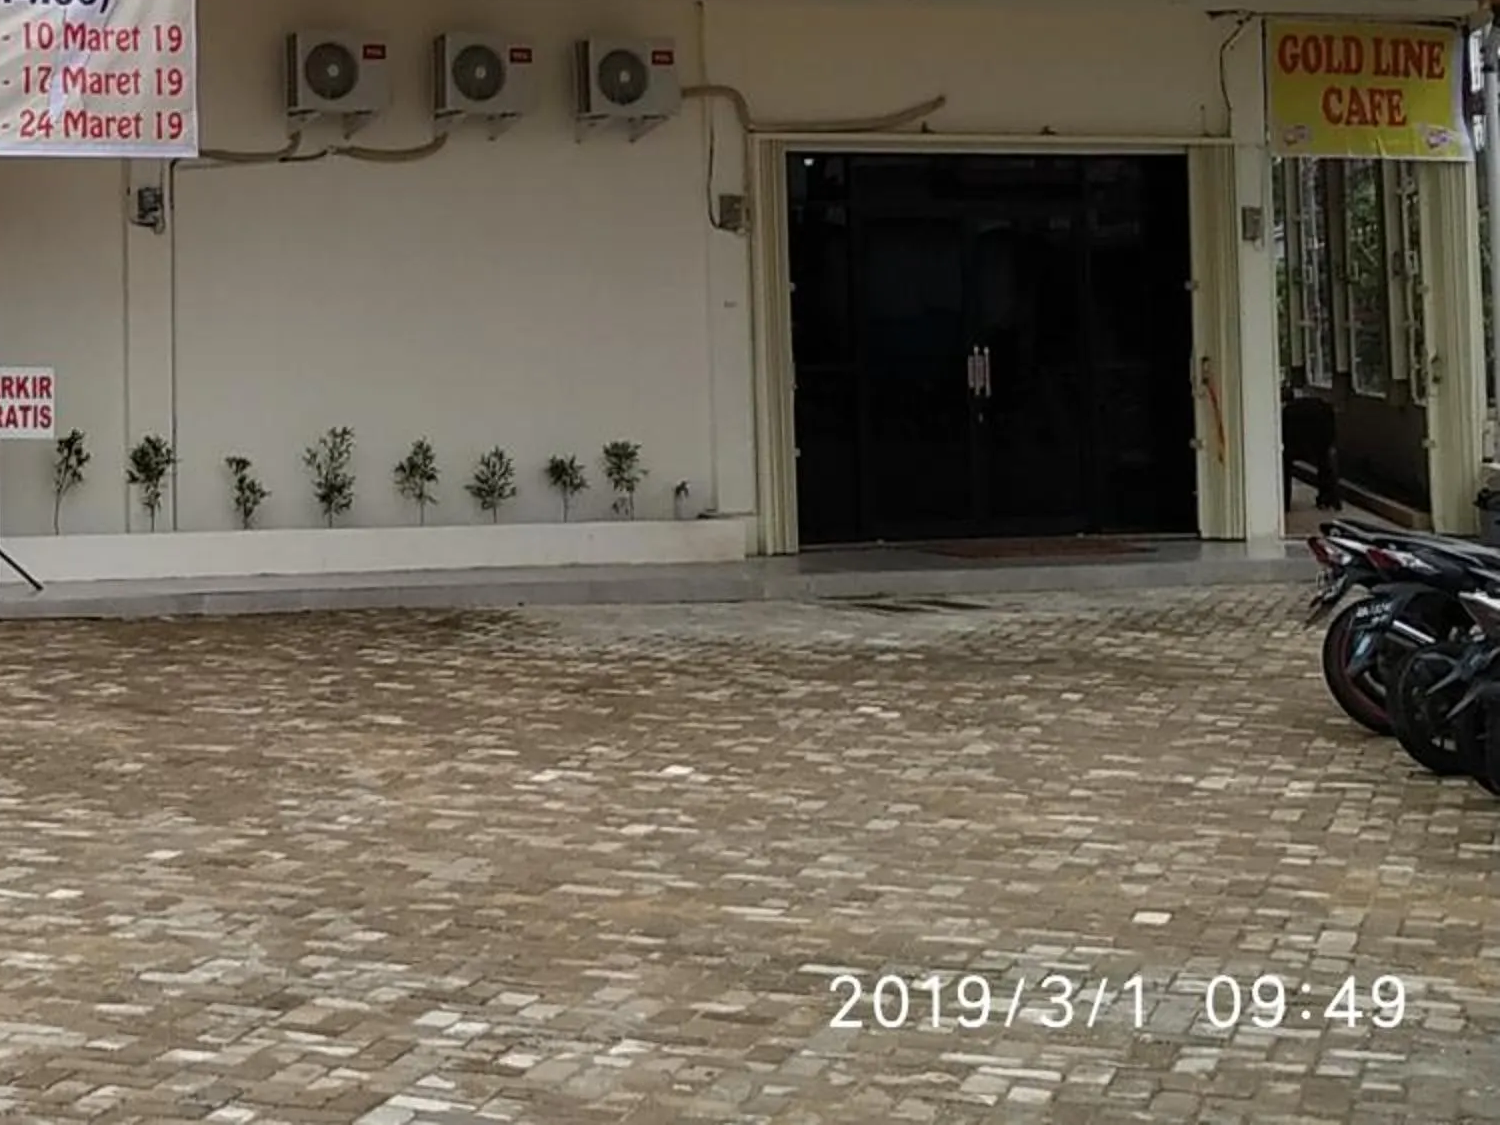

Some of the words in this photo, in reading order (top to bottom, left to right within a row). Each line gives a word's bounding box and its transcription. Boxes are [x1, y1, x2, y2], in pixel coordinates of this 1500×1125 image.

[23, 22, 54, 50] 10
[63, 22, 141, 53] Maret
[154, 24, 183, 53] 19
[1277, 34, 1364, 75] GOLD
[1373, 37, 1445, 80] LINE
[62, 66, 141, 96] Maret
[155, 68, 183, 97] 19
[1321, 84, 1407, 127] CAFE
[20, 109, 54, 138] 24
[63, 109, 142, 140] Maret
[155, 112, 183, 141] 19
